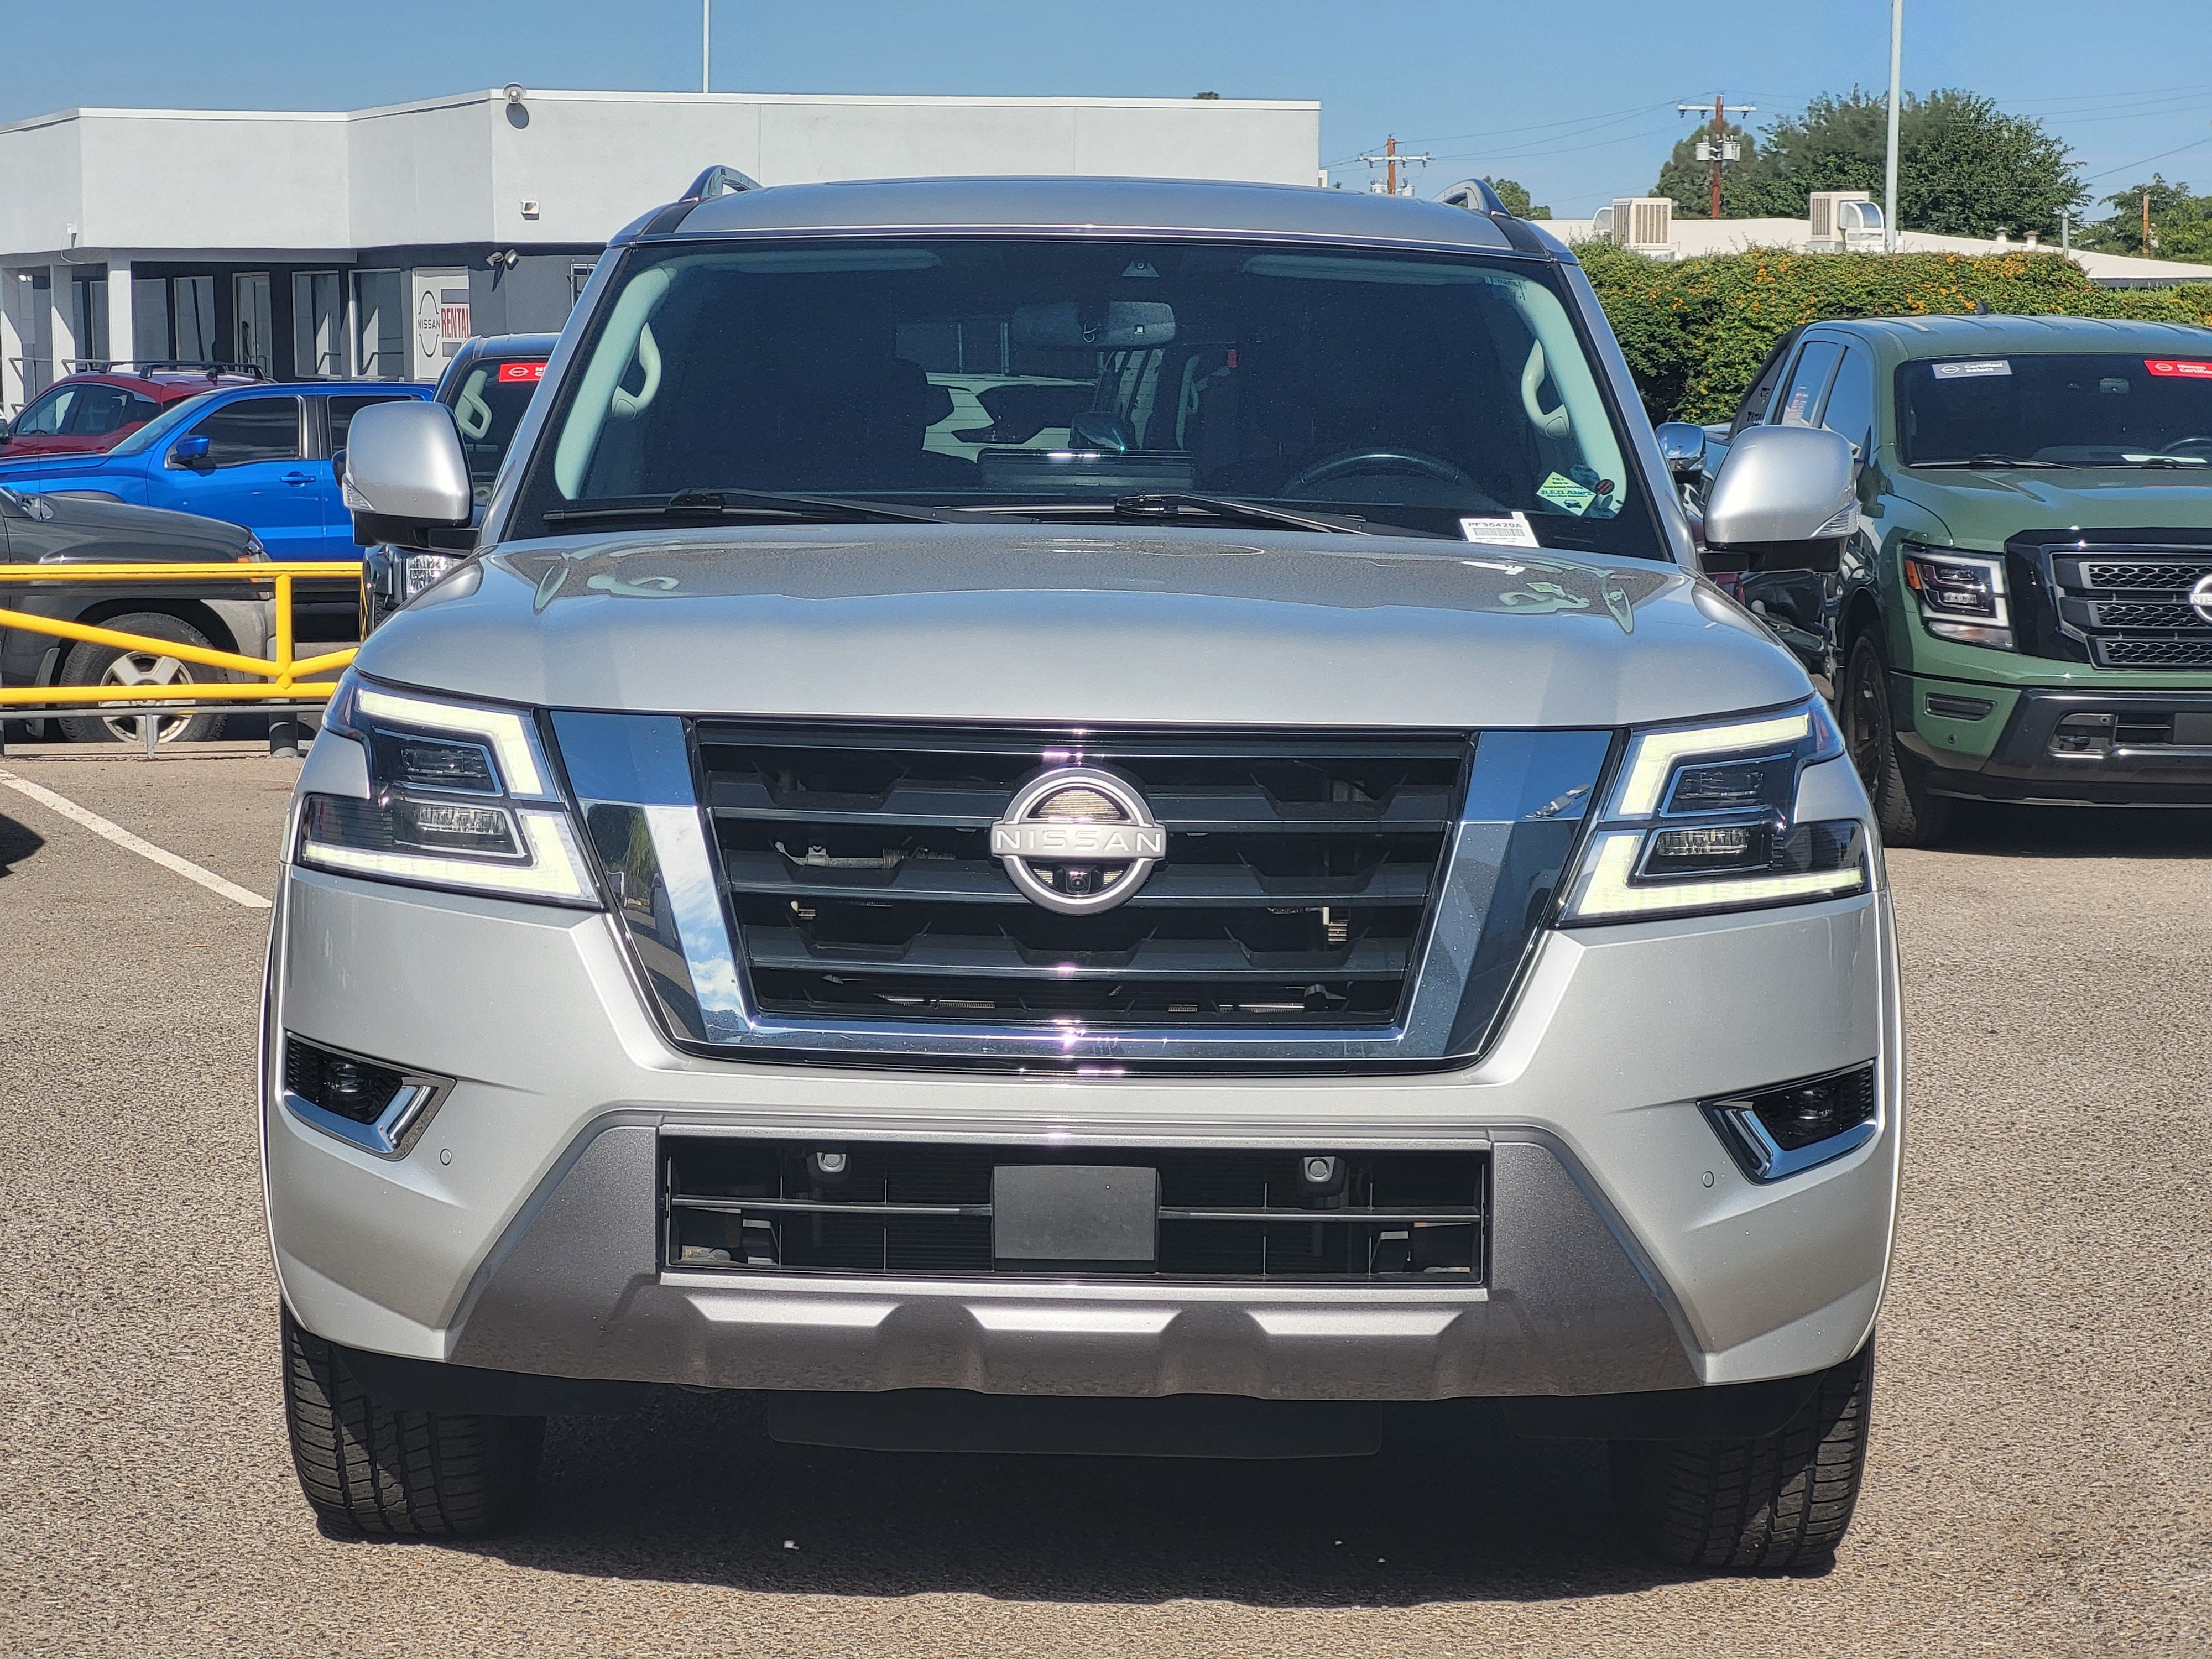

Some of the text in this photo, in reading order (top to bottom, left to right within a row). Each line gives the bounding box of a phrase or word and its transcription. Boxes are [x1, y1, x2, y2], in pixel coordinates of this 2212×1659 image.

[418, 319, 440, 329] NISSAN
[441, 307, 471, 338] RENTAL
[996, 830, 1161, 853] NISSAN
